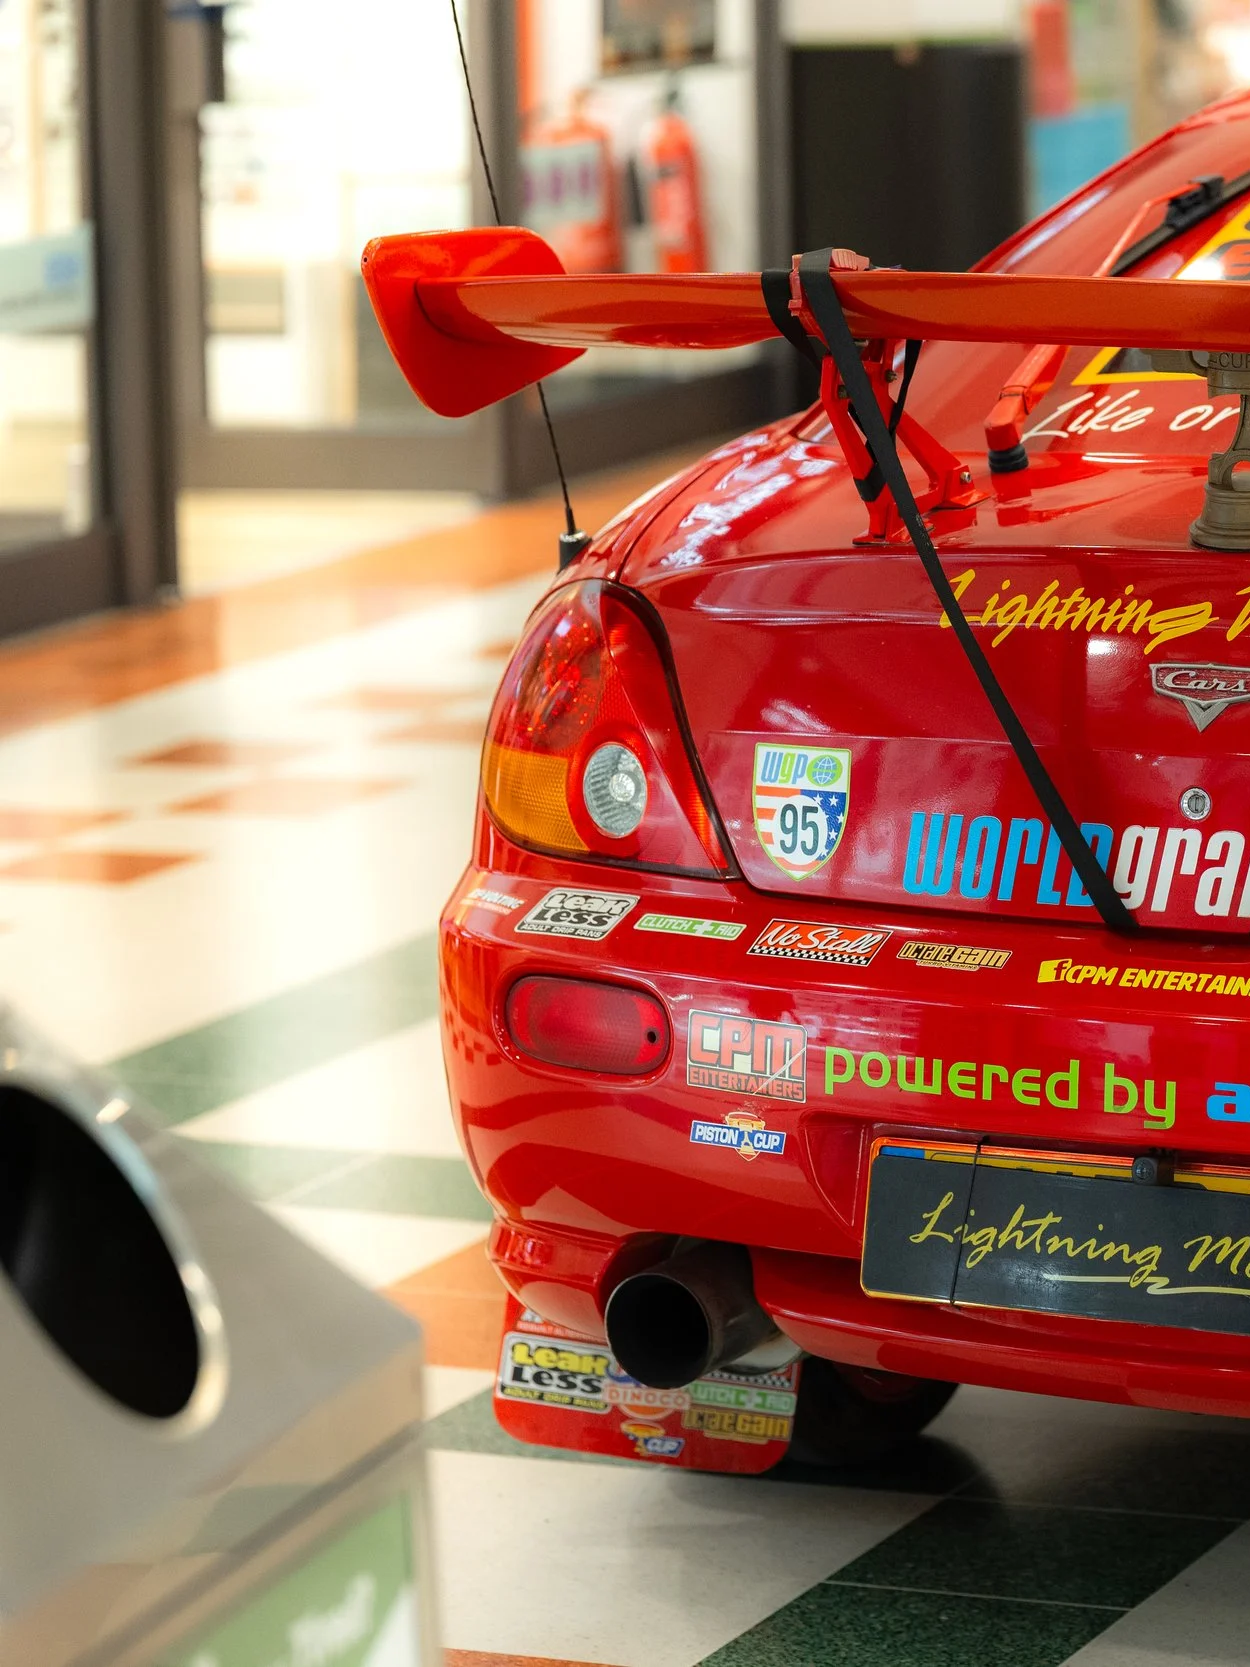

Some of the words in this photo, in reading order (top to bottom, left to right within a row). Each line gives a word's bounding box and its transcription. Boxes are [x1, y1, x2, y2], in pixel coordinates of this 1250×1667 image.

[1020, 389, 1154, 442] Like
[939, 568, 1219, 655] Lightning
[1162, 669, 1248, 695] Cars
[780, 803, 819, 856] 95
[533, 909, 612, 927] Less
[544, 892, 630, 916] Leak
[640, 916, 690, 931] CLUTCH
[714, 924, 742, 937] AID
[757, 923, 803, 946] No
[797, 927, 884, 954] Stall
[690, 1013, 805, 1077] CPM
[689, 1066, 803, 1098] ENTERTAINERS
[824, 1046, 1080, 1110] powered
[1103, 1062, 1177, 1129] by
[694, 1123, 739, 1145] PISTON
[753, 1133, 781, 1150] CUP
[909, 1191, 1162, 1287] Lightning
[511, 1342, 609, 1377] Leak
[511, 1366, 602, 1394] Less
[607, 1387, 686, 1407] DINOCO
